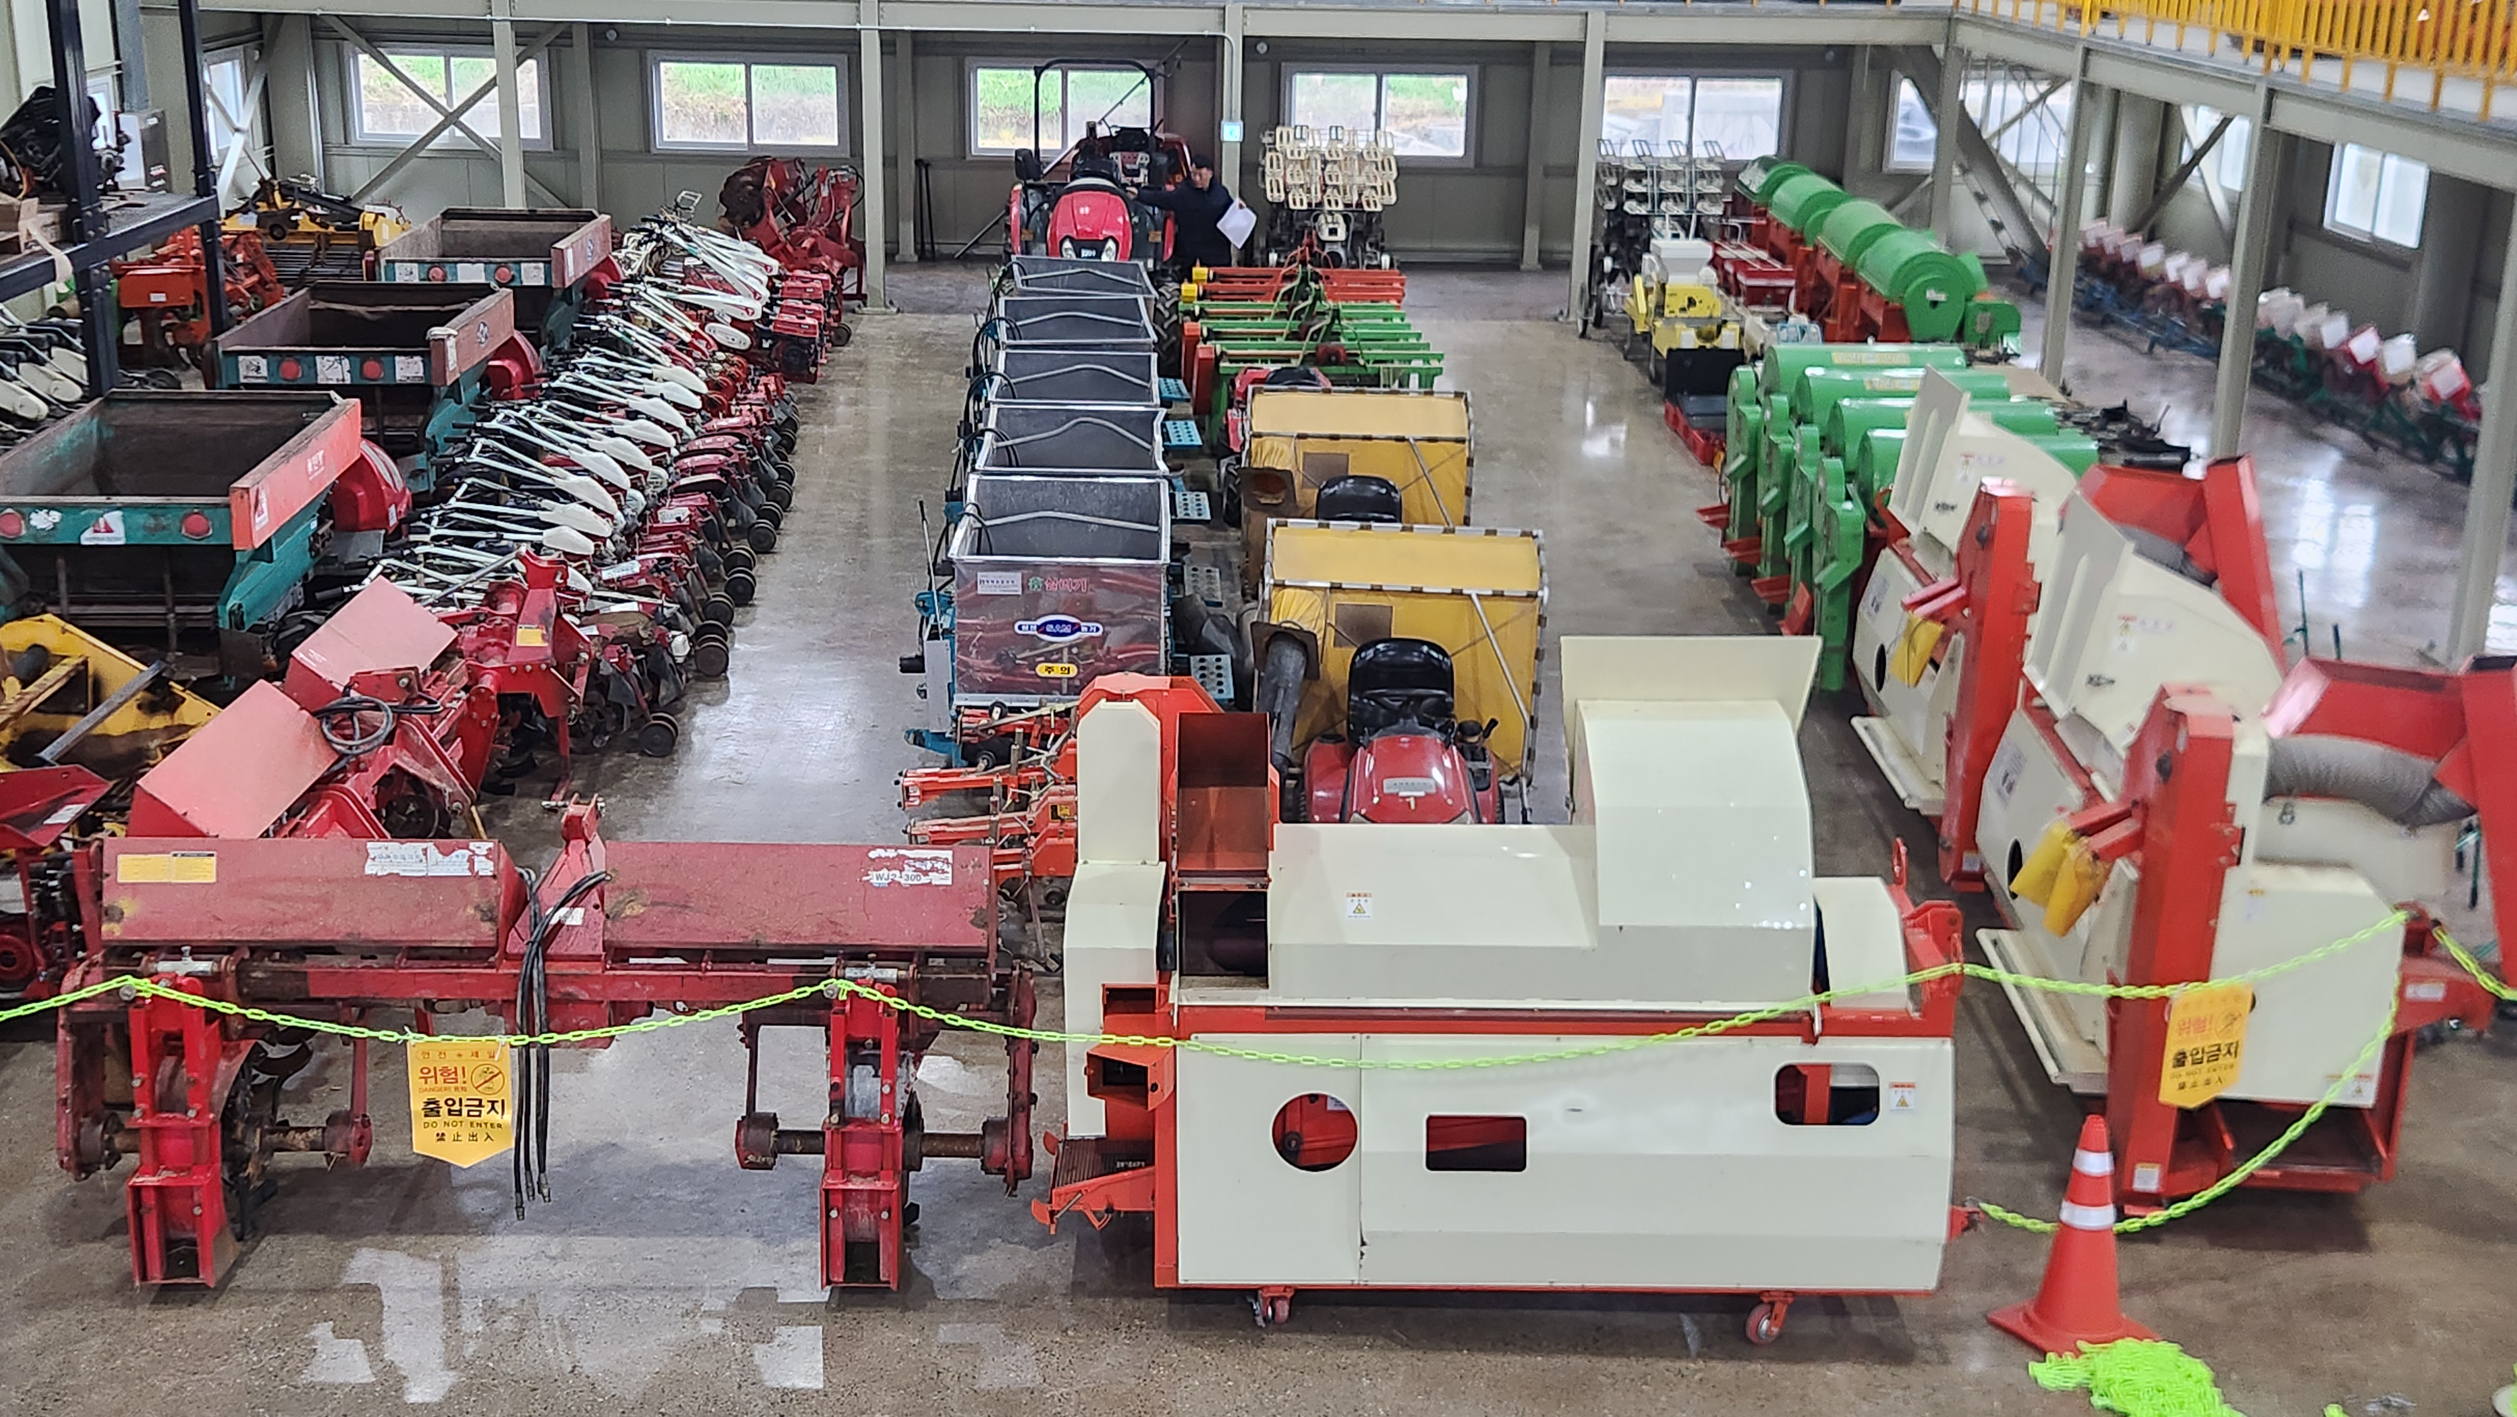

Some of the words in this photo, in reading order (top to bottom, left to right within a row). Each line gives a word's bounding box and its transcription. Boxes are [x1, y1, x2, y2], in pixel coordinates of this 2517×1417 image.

[2172, 1040, 2240, 1069] 출입금지
[418, 1065, 468, 1085] 위험!
[420, 1096, 506, 1119] 출입금지
[422, 1121, 439, 1129] DO
[443, 1120, 464, 1129] NOT
[469, 1121, 503, 1130] ENTER
